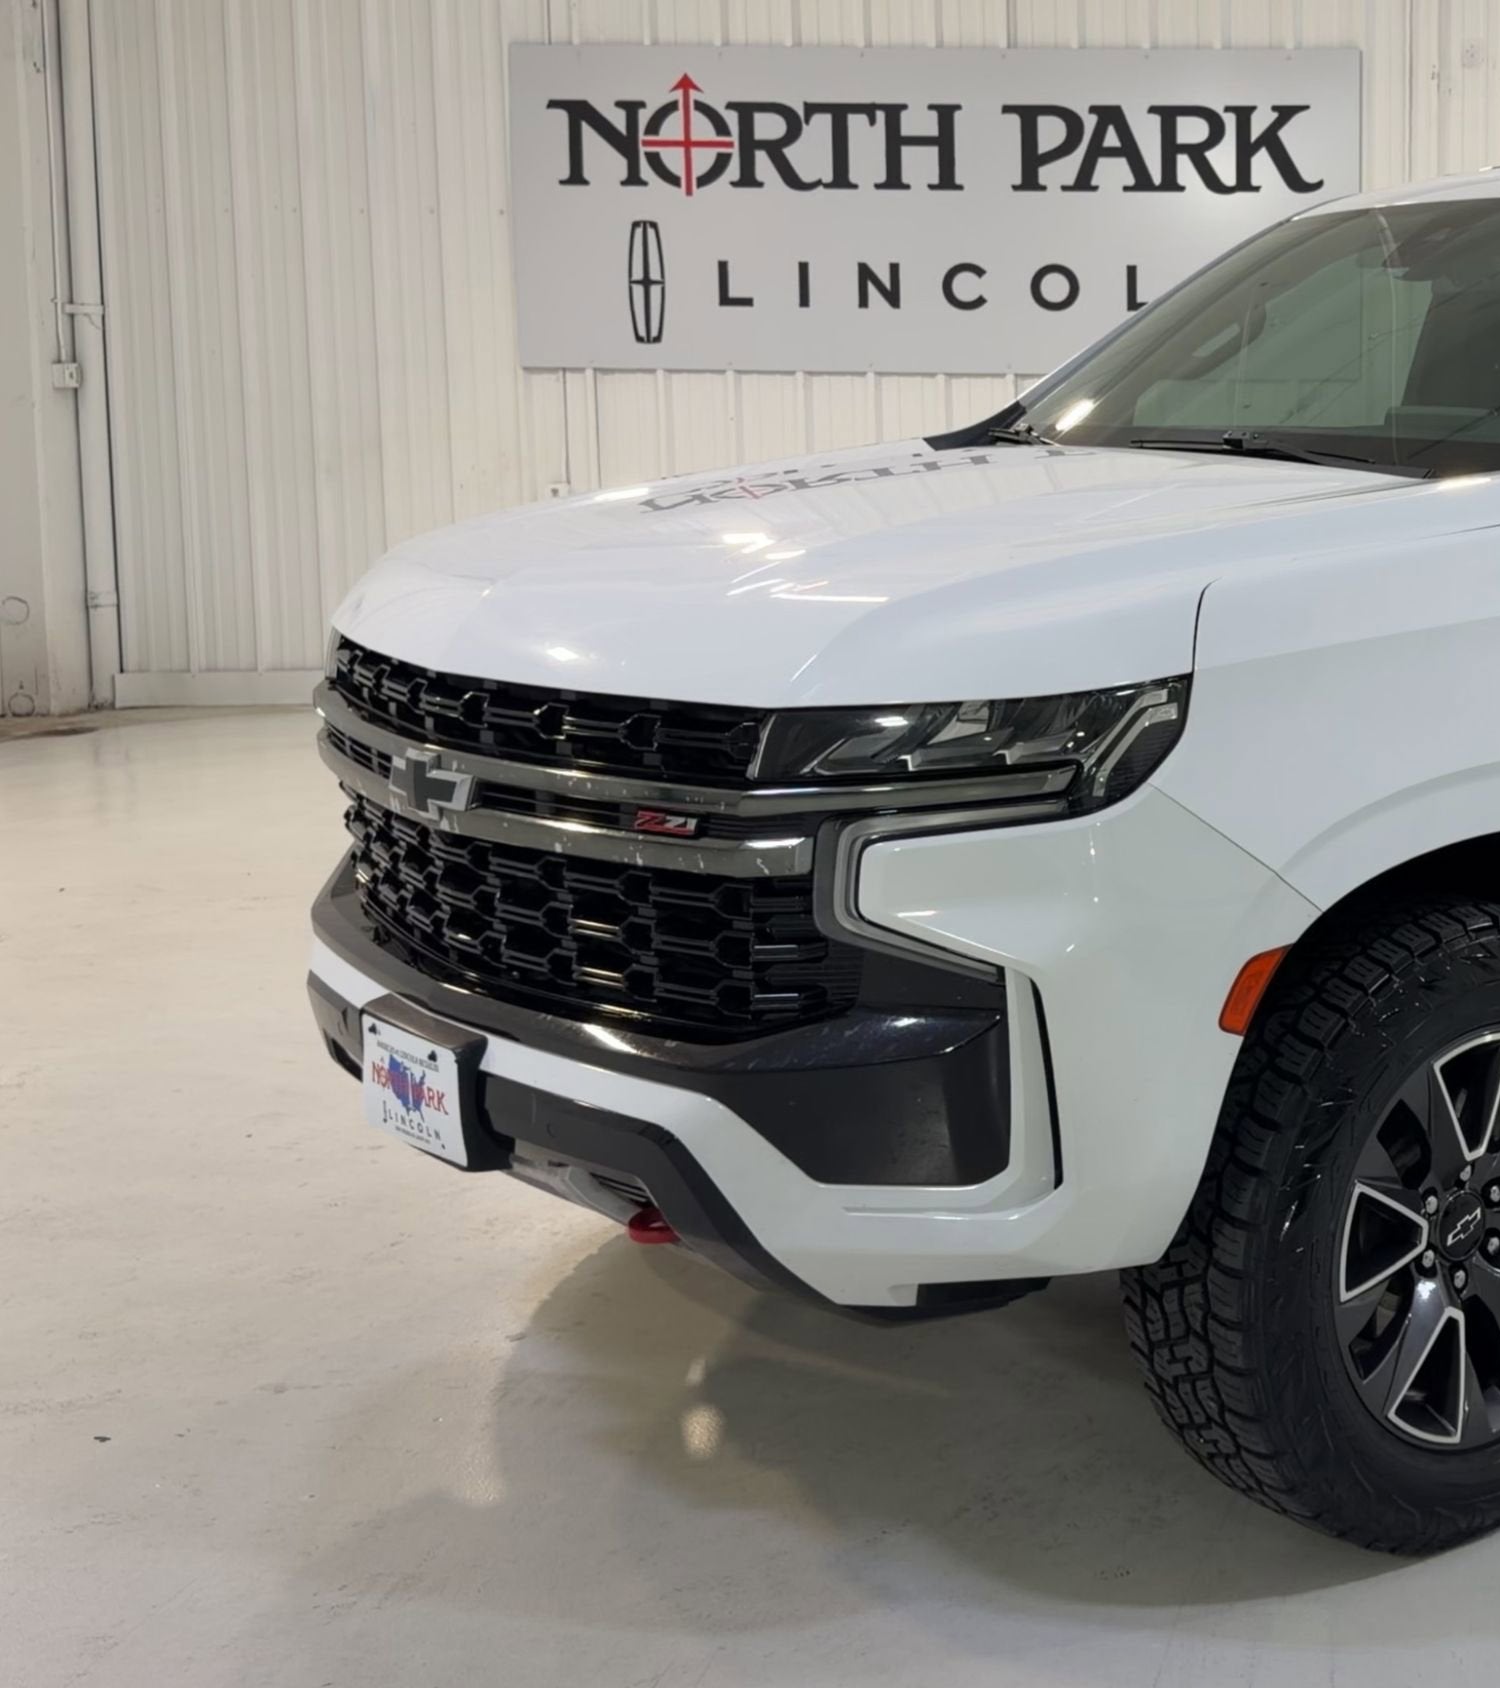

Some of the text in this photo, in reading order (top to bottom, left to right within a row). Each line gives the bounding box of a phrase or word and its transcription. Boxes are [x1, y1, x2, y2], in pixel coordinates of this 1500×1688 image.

[546, 98, 1324, 196] NORTH PARK
[717, 260, 1149, 312] LINCOL
[634, 810, 698, 836] Z71
[371, 1061, 449, 1116] NOR ARK
[388, 1108, 442, 1141] LINCOLN
